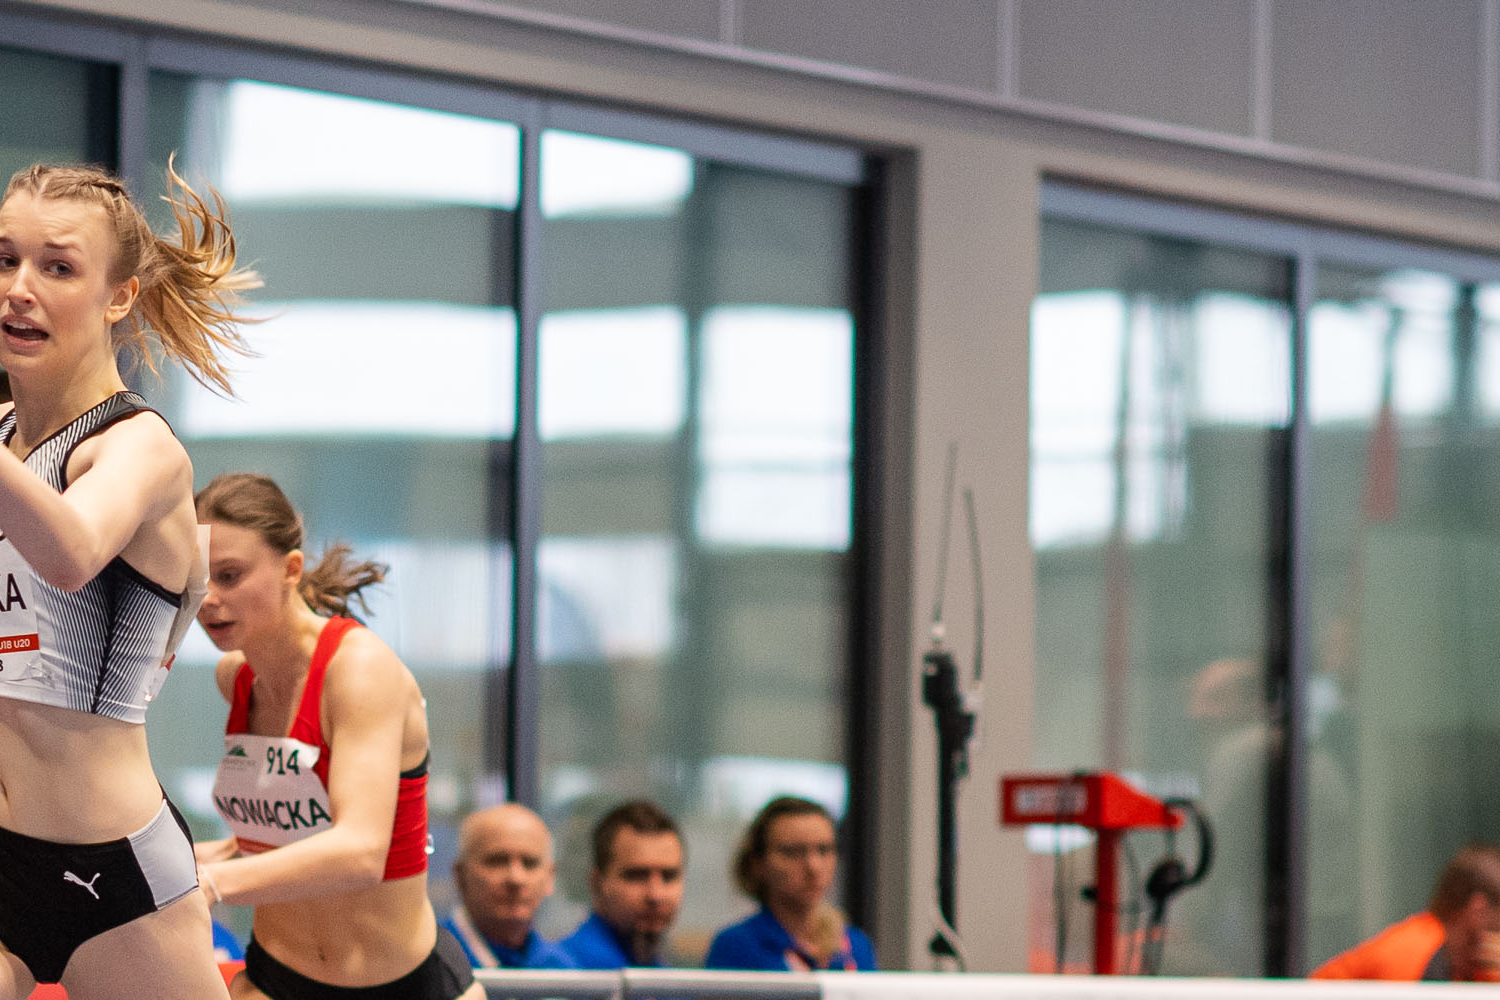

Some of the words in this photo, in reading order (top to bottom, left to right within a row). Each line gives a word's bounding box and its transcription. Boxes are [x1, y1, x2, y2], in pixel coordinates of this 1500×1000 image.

[13, 638, 31, 649] U20
[267, 746, 300, 775] 914
[215, 796, 333, 830] NOWACKA
